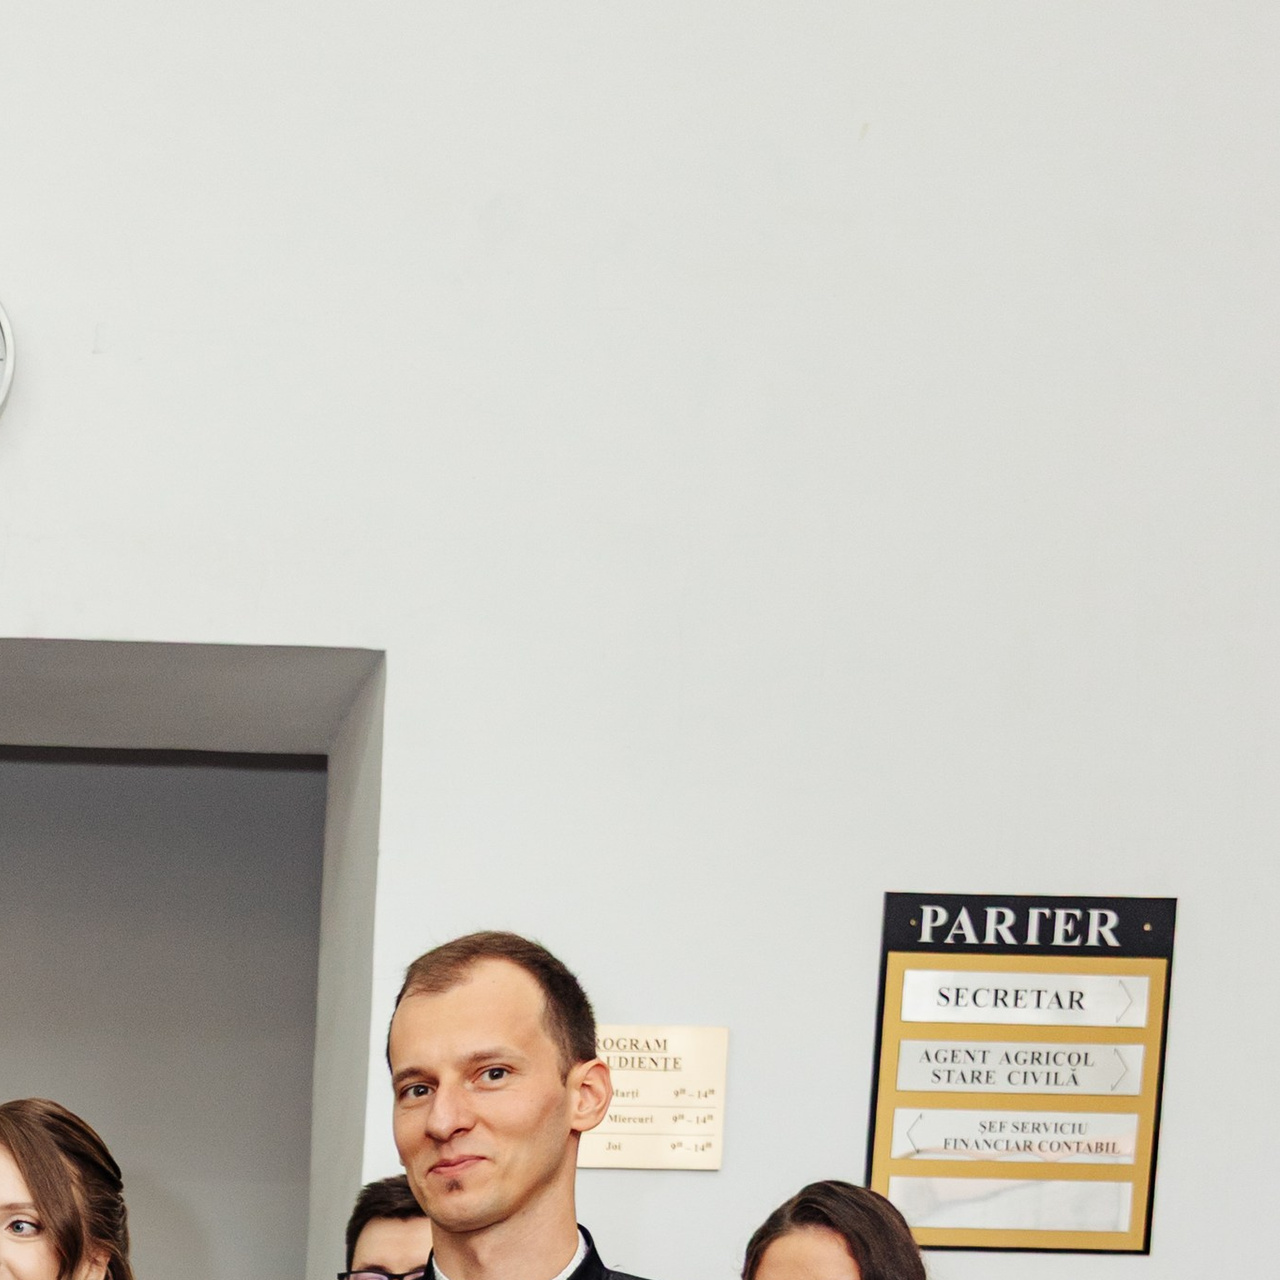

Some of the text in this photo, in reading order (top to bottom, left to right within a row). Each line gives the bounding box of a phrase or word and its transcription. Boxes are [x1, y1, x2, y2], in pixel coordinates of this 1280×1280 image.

[917, 904, 1121, 947] PARTER
[936, 986, 1086, 1011] SECRETAR
[595, 1038, 668, 1051] ROGRAM
[919, 1048, 1095, 1067] AGENT AGRICOL
[931, 1068, 1080, 1087] STARE CIVILĂ
[609, 1114, 654, 1123] Miercuri
[1010, 1121, 1088, 1136] SERVICIU
[606, 1141, 622, 1151] Joi
[943, 1137, 1121, 1155] FINANCIAR CONTABIL
